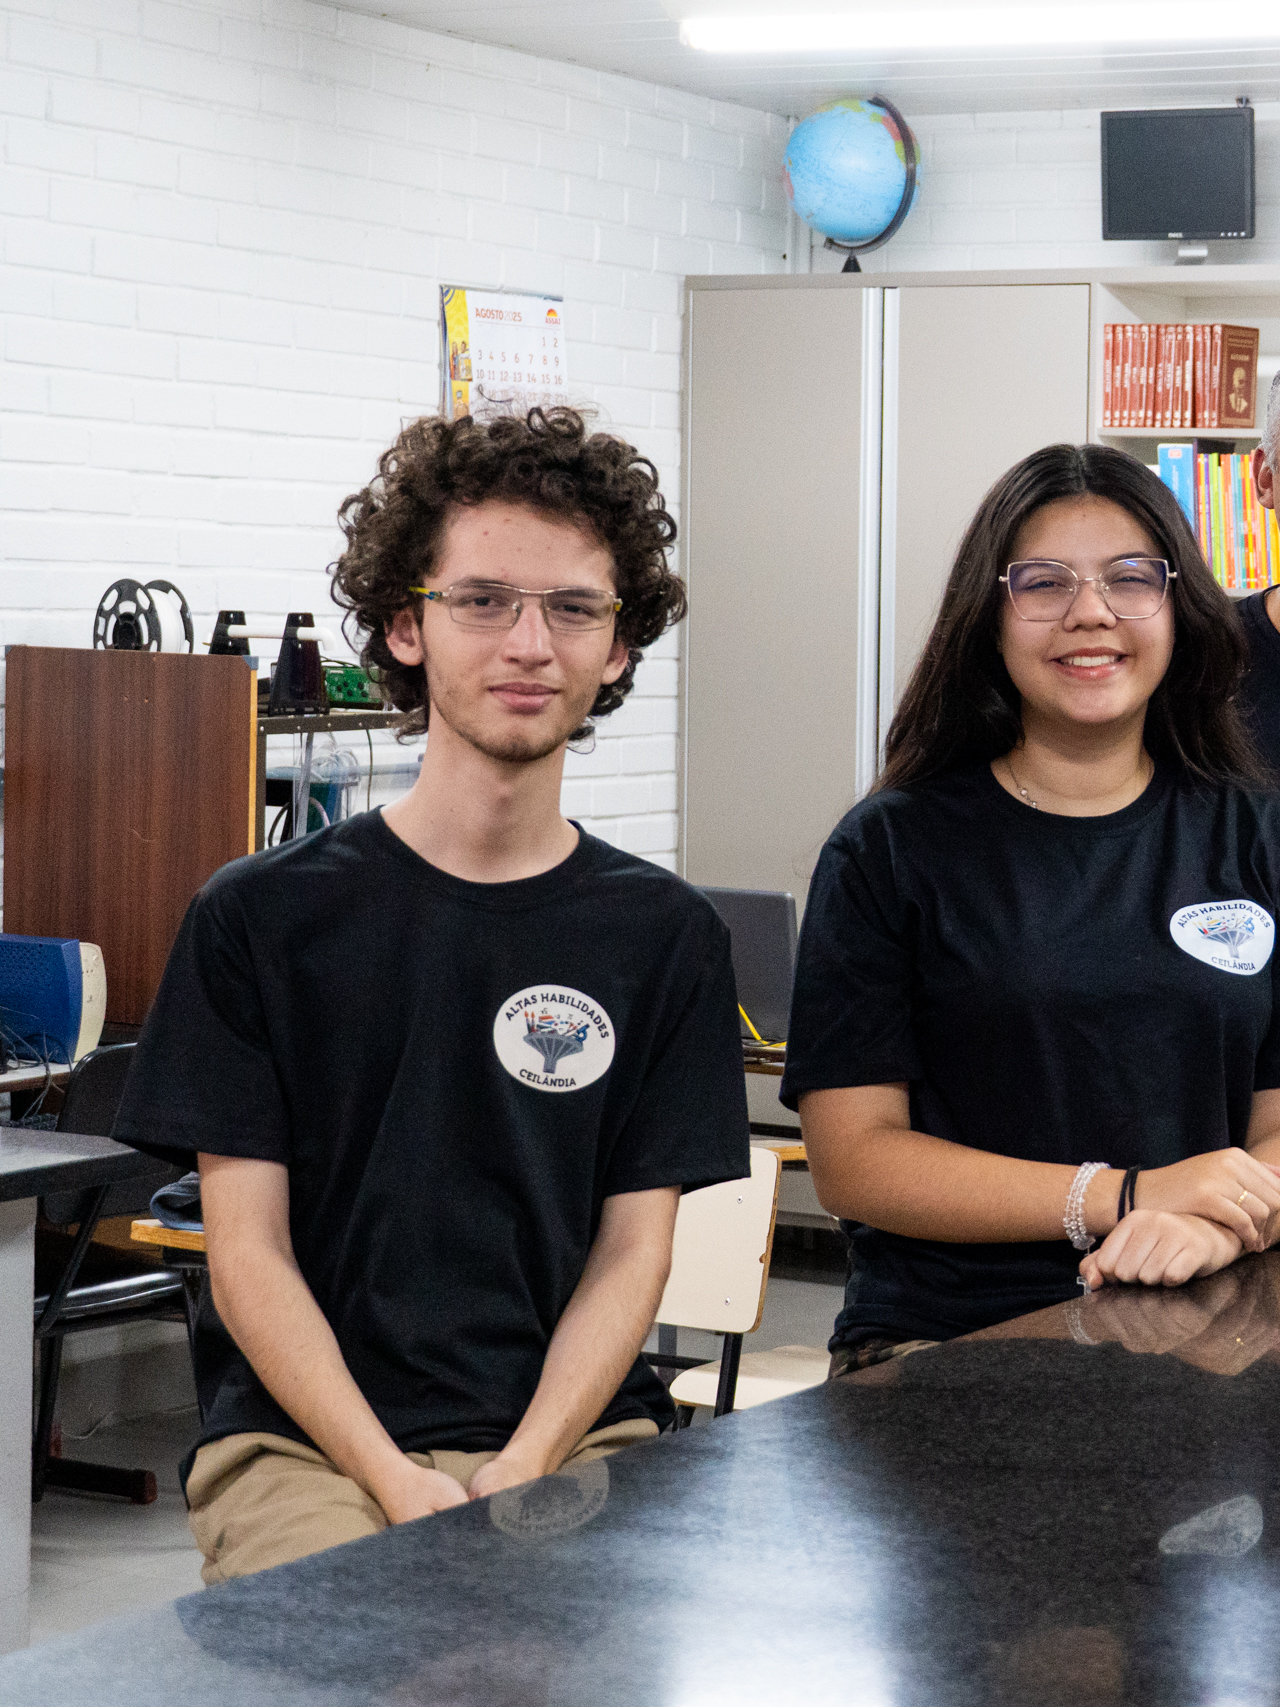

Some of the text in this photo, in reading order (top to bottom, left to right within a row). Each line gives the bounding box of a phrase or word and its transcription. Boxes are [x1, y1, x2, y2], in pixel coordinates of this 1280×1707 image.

[475, 307, 522, 322] AGOSTO 2025
[553, 337, 558, 348] 2
[478, 349, 560, 366] 3 4 5 6 7 8 9
[476, 369, 563, 385] 10 11 12 13 14 15 16
[1177, 903, 1271, 928] ALTAS HABILIDADES
[1211, 956, 1256, 971] CEILÂNDIA
[505, 993, 610, 1039] ALTAS HABILIDADES
[519, 1068, 577, 1088] CEILÂNDIA
